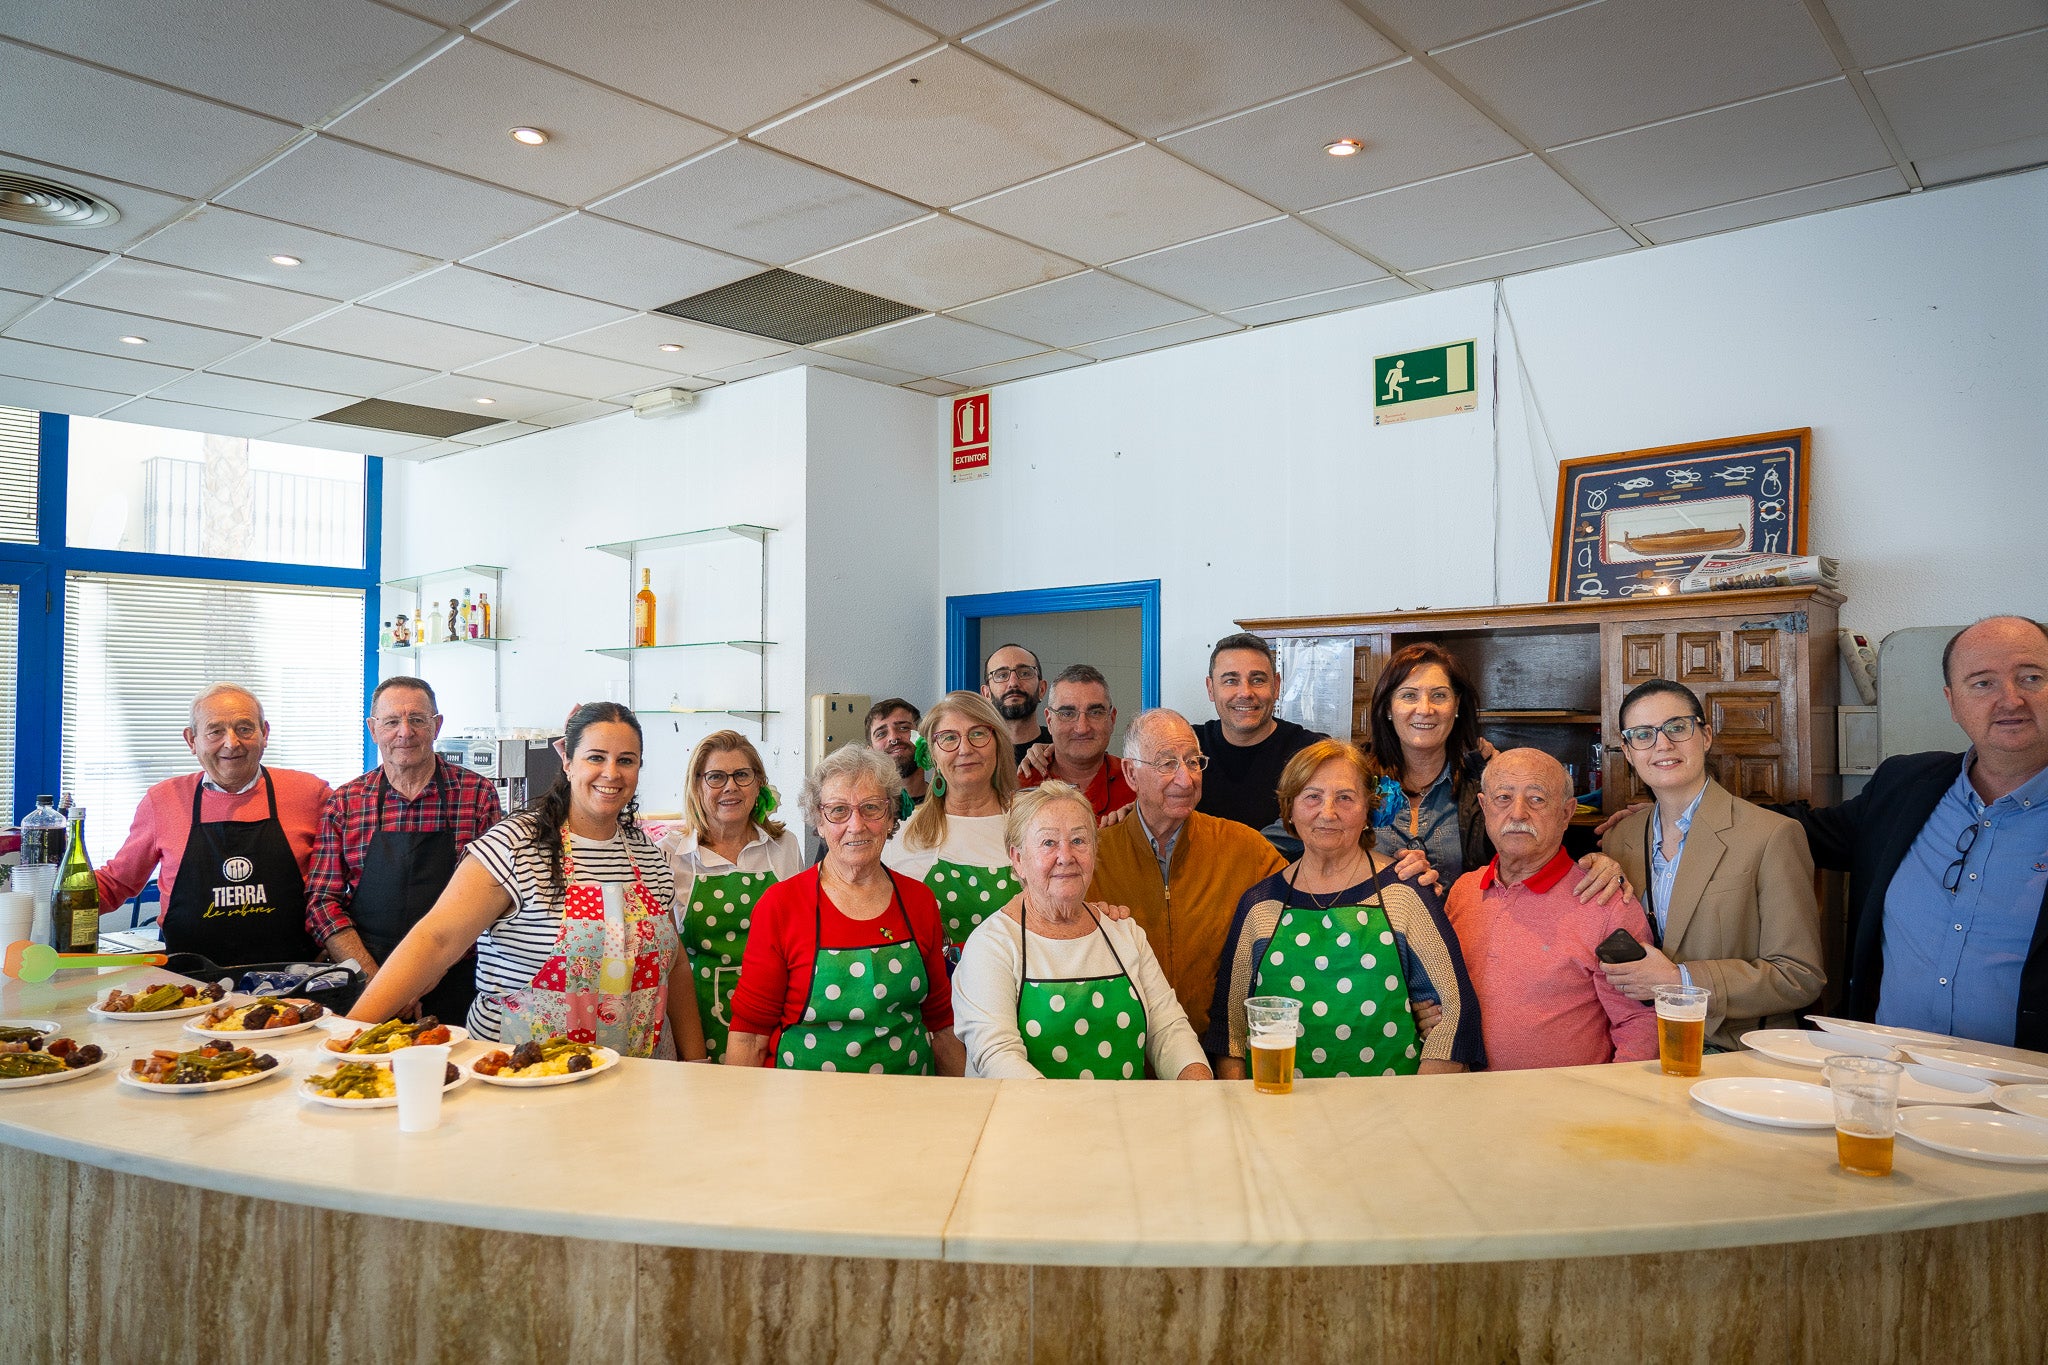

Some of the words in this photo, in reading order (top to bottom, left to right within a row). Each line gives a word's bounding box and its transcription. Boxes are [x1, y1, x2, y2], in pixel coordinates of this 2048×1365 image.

[955, 453, 987, 465] EXTINTOR
[212, 884, 267, 908] TIERRA
[203, 901, 225, 918] de
[227, 900, 276, 917] sabores
